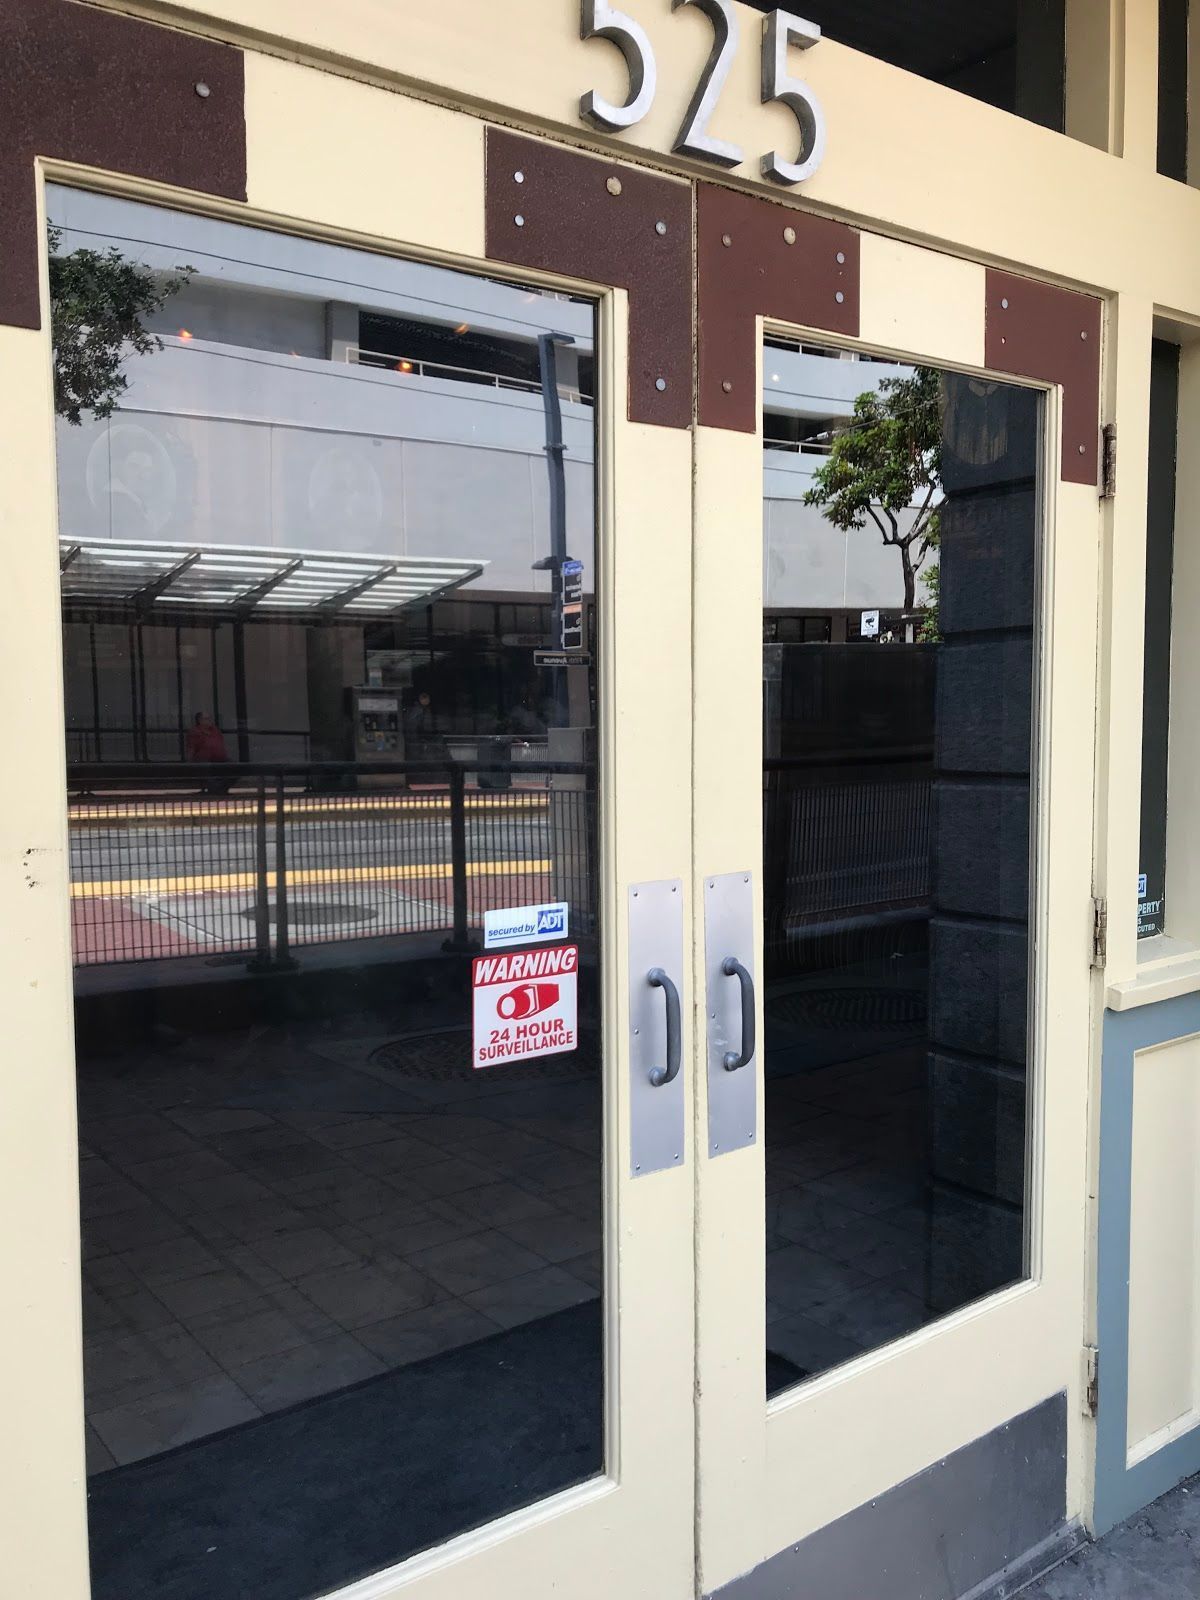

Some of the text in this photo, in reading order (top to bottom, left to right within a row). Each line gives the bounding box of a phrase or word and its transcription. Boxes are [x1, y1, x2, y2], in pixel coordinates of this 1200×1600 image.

[579, 0, 827, 186] 525
[1137, 901, 1160, 914] PERTY
[488, 911, 564, 937] secured by ADT
[1137, 923, 1155, 932] CUTED
[475, 948, 576, 984] WARNING
[490, 1018, 564, 1045] 24 HOUR
[479, 1031, 574, 1061] SURVEILLANCE
